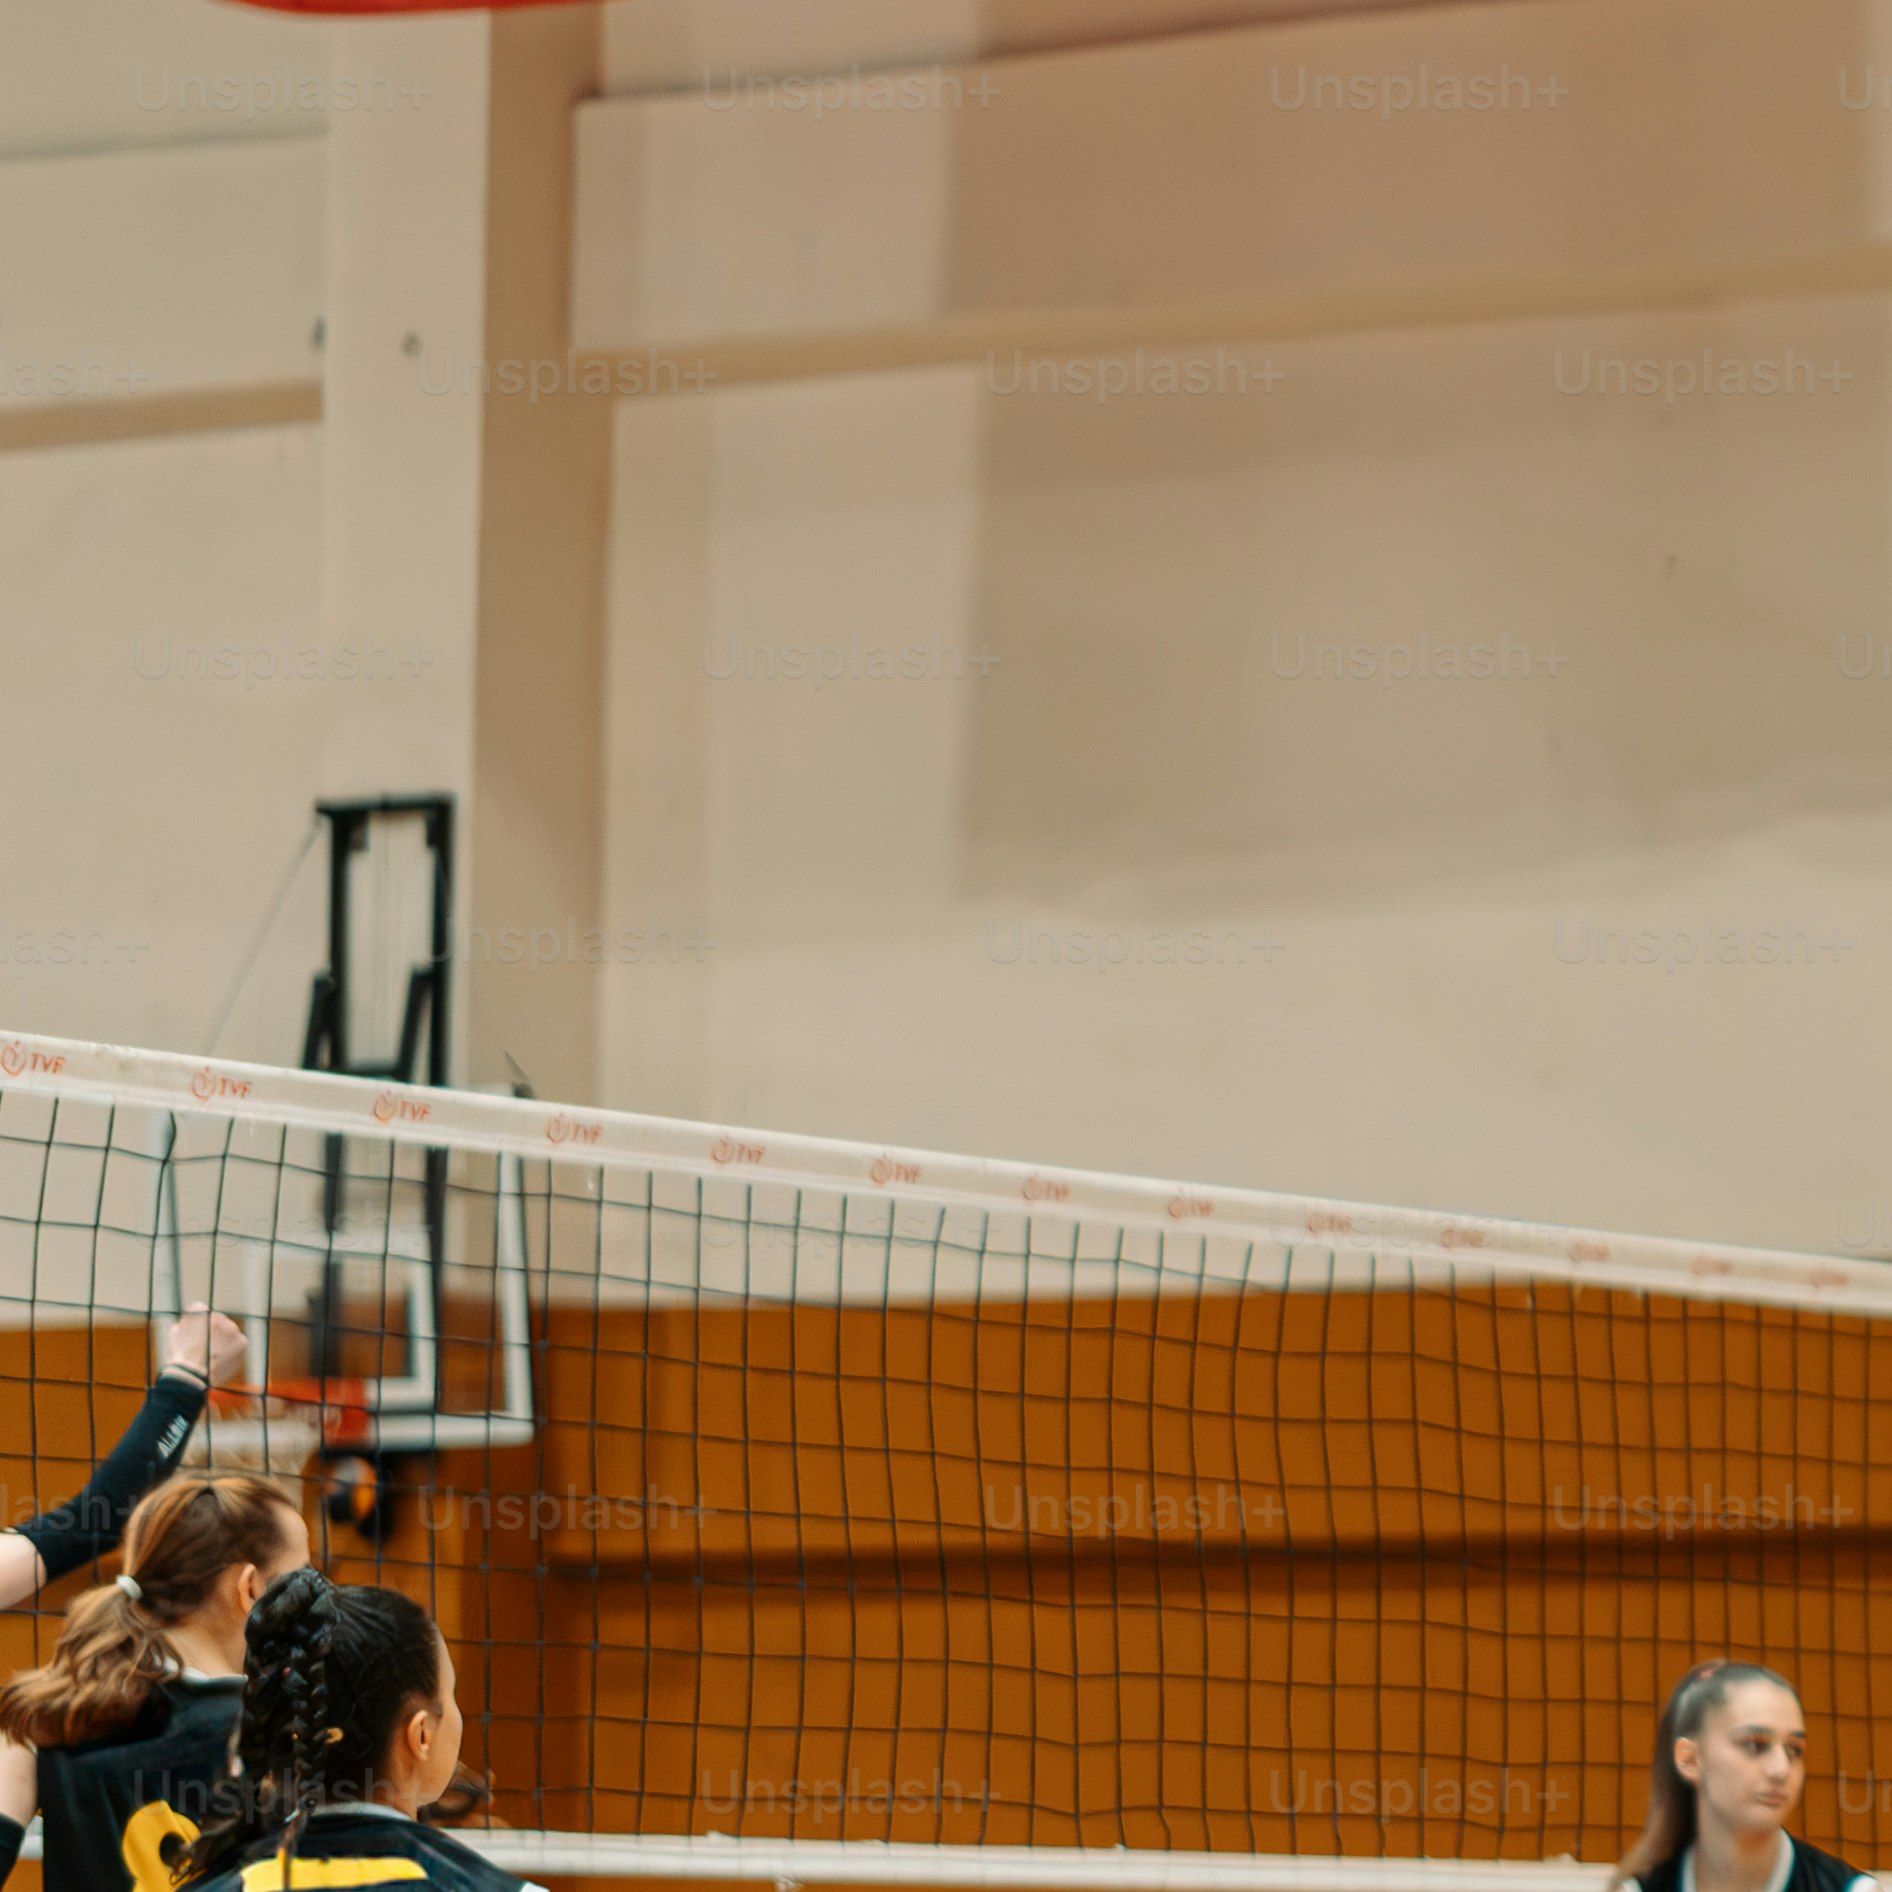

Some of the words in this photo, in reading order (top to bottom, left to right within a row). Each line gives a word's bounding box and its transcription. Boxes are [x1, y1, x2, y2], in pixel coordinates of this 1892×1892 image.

[31, 1053, 66, 1074] TVF
[219, 1077, 251, 1098] TVF
[400, 1100, 432, 1121] TVF
[571, 1121, 602, 1145] TVF
